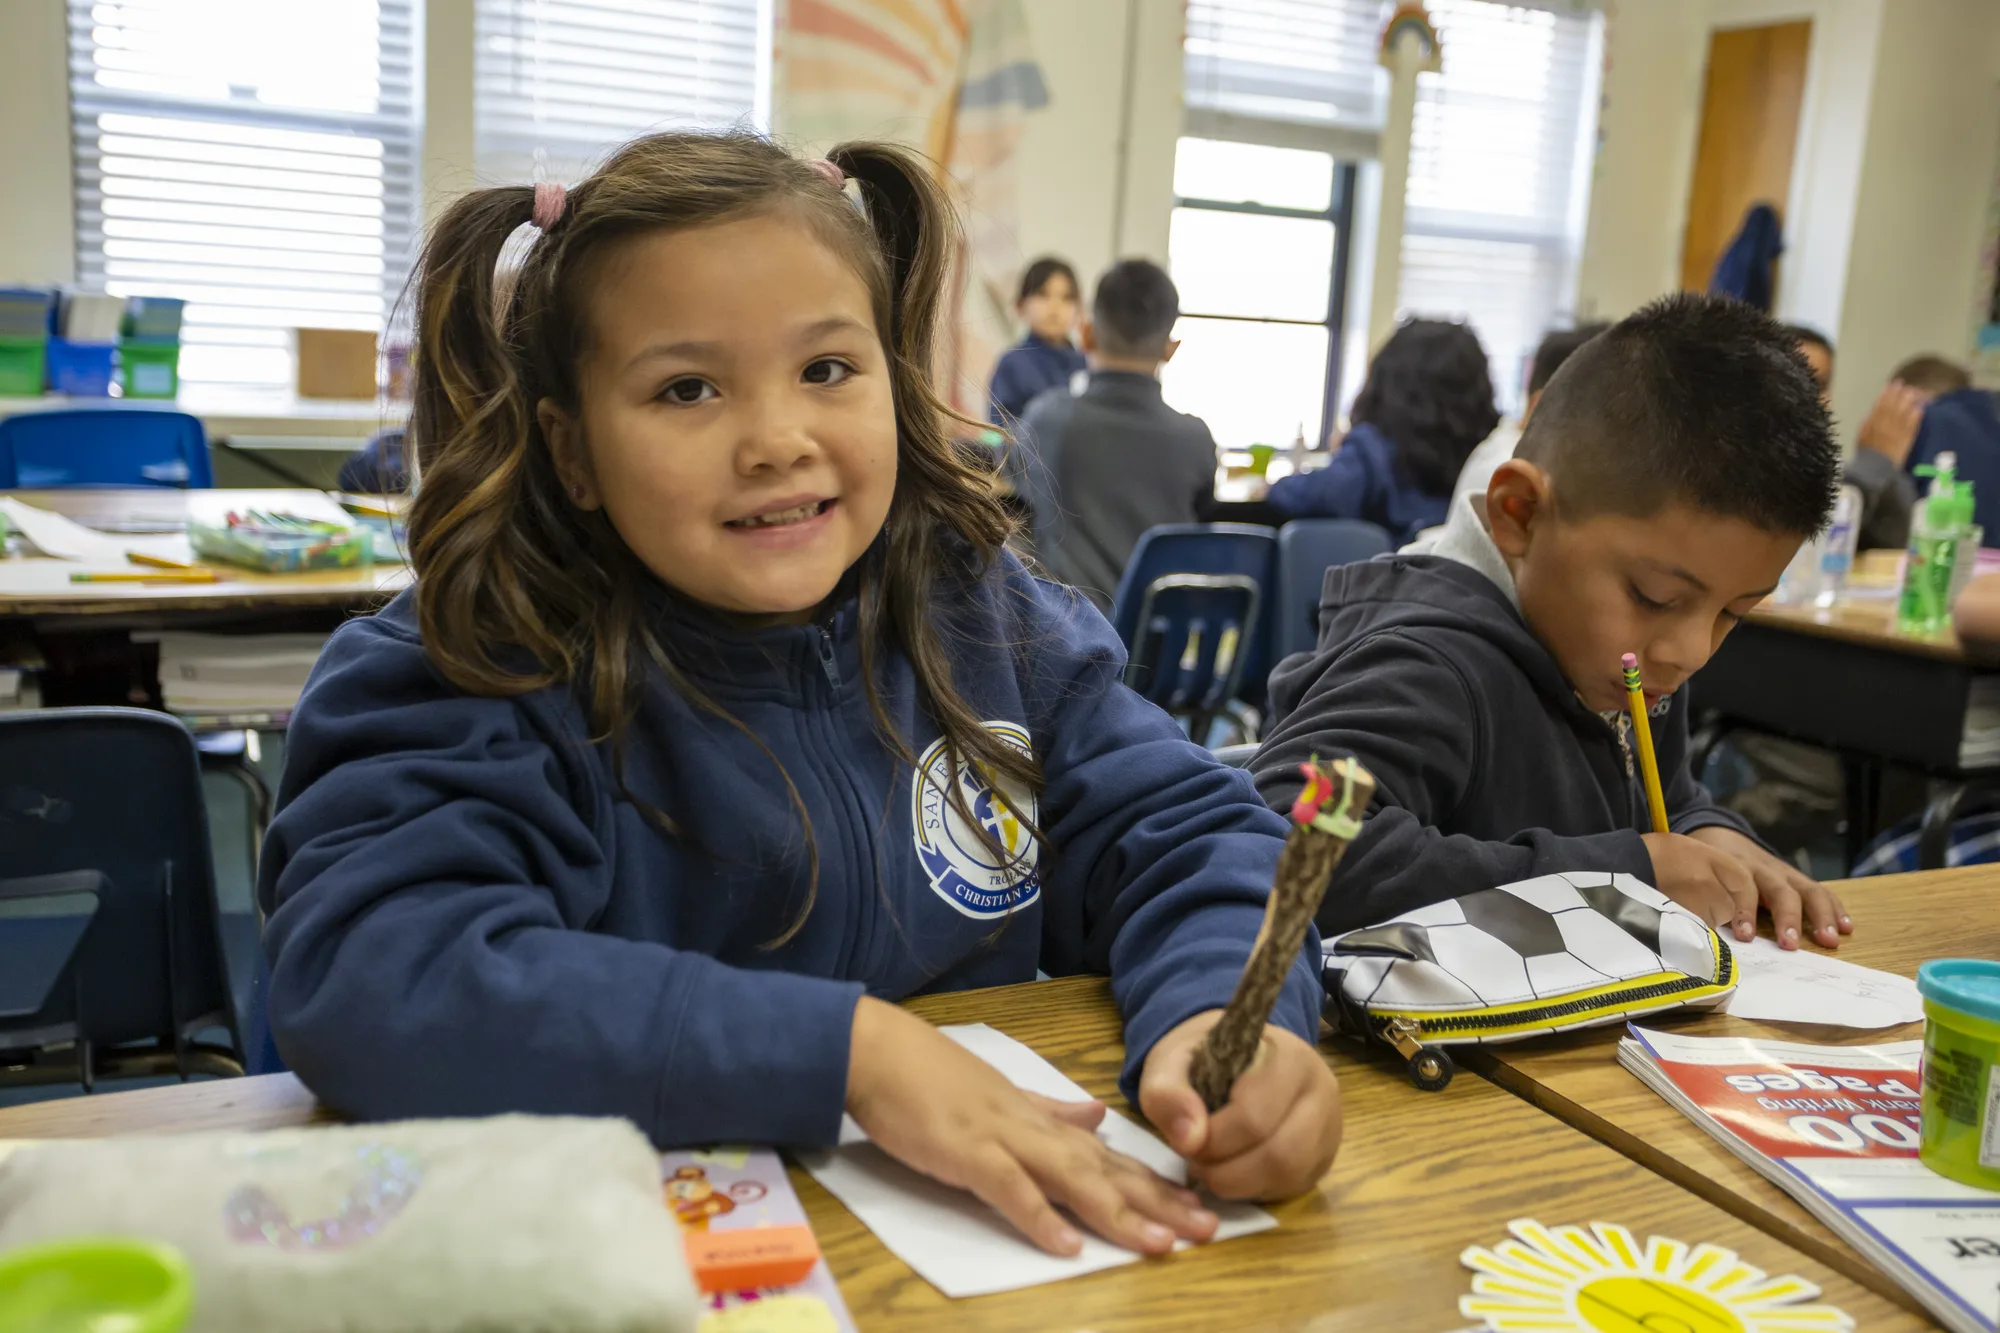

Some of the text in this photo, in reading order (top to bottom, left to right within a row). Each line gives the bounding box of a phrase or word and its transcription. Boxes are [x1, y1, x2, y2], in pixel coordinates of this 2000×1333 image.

[924, 780, 940, 829] SAN
[955, 883, 1021, 907] CHRISTIAN
[1724, 1069, 1921, 1098] Pages
[1755, 1097, 1866, 1113] Writing
